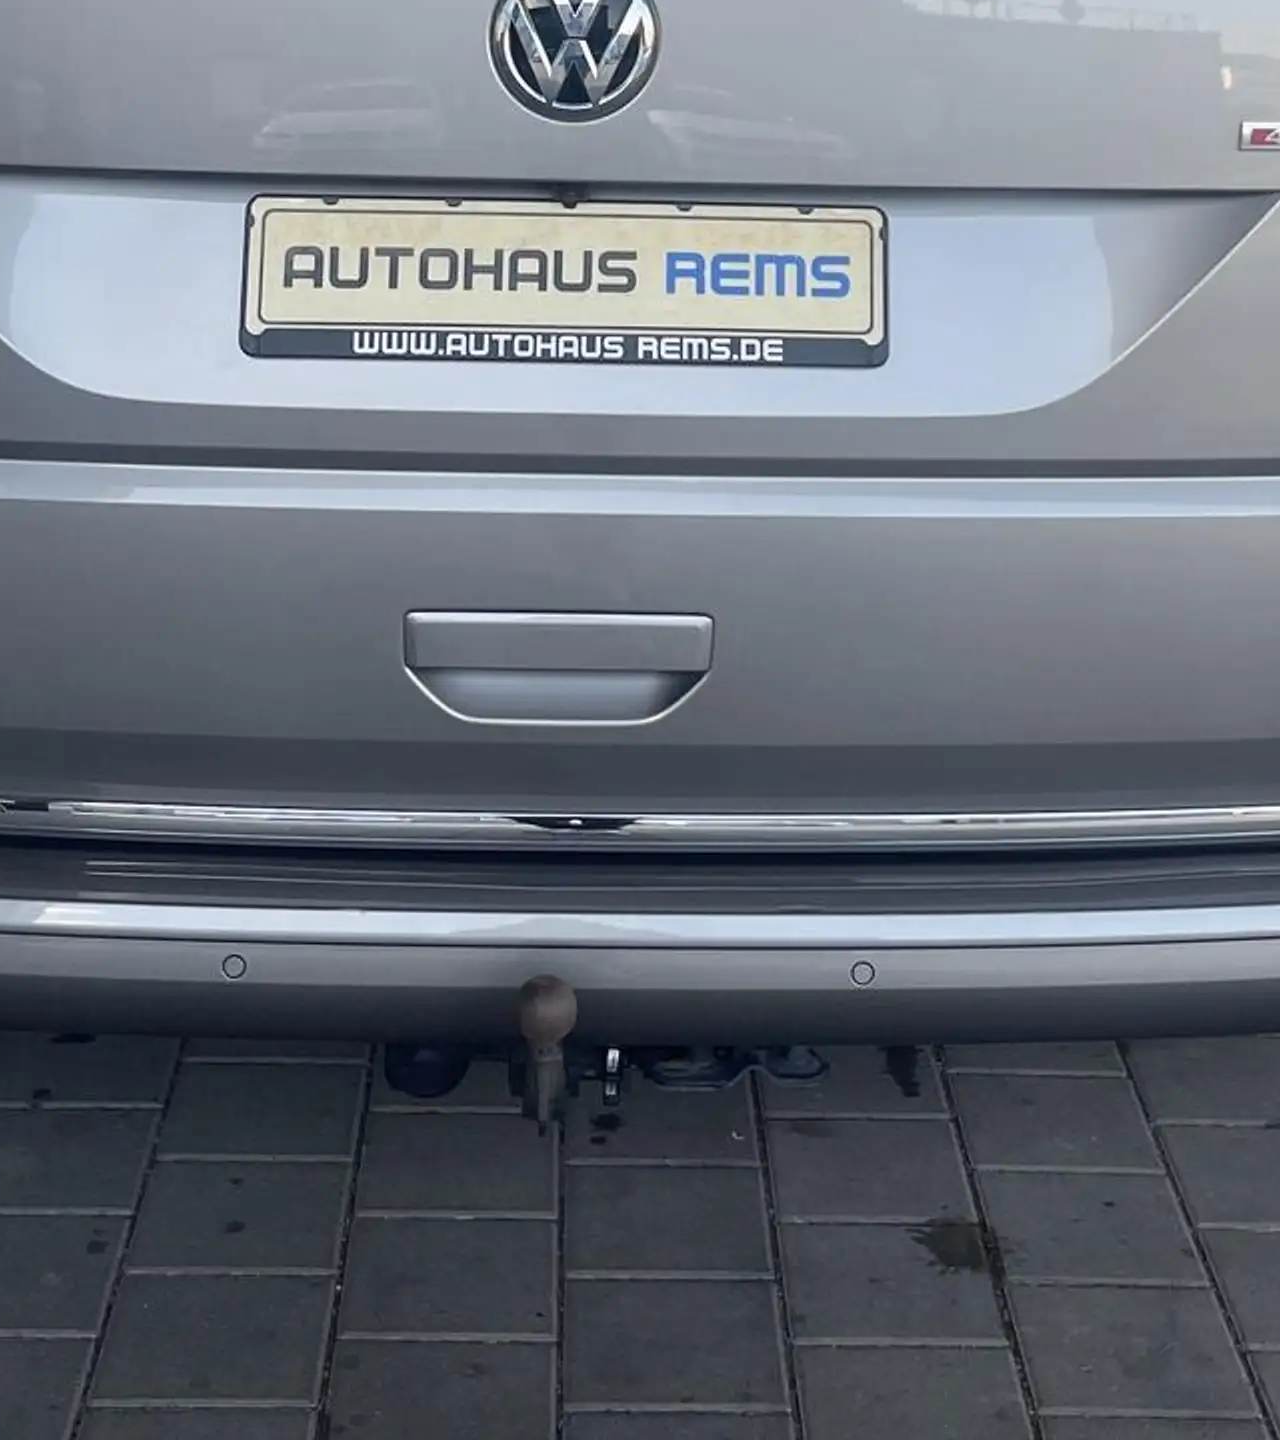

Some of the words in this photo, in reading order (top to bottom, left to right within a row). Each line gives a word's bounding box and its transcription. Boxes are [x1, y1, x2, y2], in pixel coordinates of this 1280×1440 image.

[282, 245, 638, 294] AUTOHAUS
[664, 250, 852, 298] REMS
[352, 330, 624, 359] WWW.AUTOHAUS
[637, 337, 785, 362] REMS.DE
